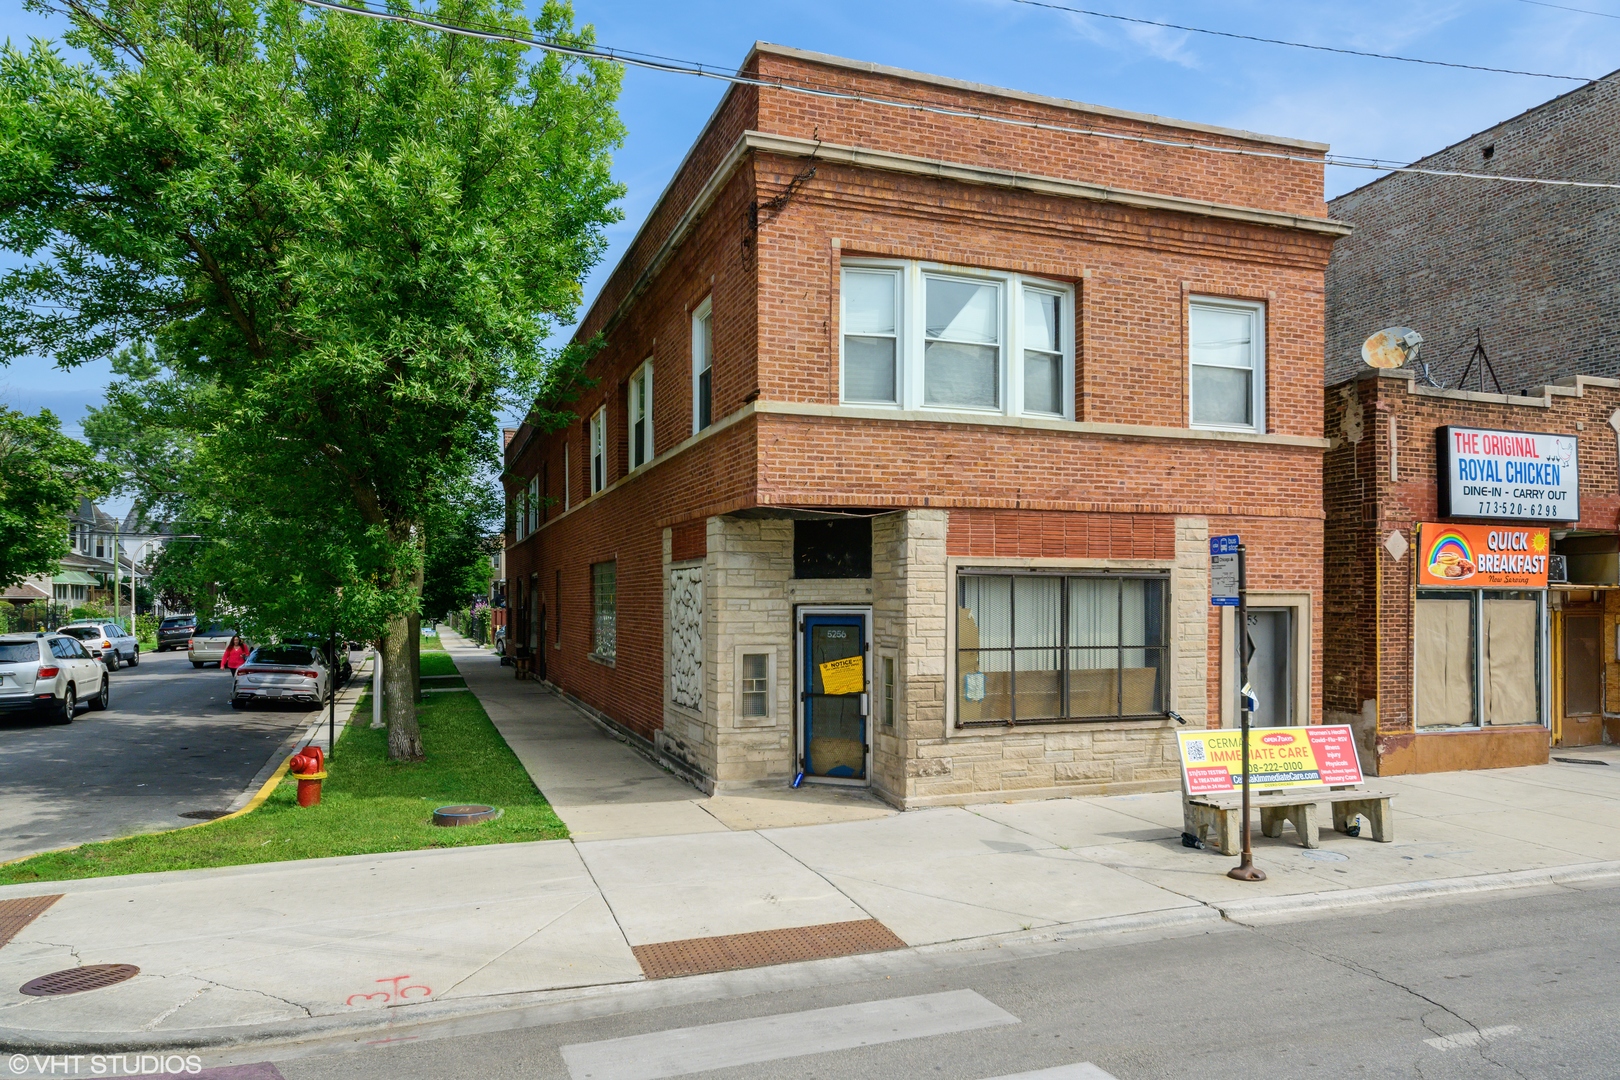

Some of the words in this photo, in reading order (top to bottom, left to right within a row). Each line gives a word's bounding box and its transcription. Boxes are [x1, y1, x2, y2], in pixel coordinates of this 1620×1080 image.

[1454, 432, 1479, 454] THE
[1482, 434, 1539, 458] ORIGINAL
[1458, 458, 1502, 483] ROYAL
[1505, 460, 1560, 486] CHICKEN
[1463, 485, 1502, 497] DINE-IN
[1513, 488, 1545, 499] CARRY
[1547, 490, 1567, 501] OUT
[1487, 531, 1529, 552] QUICK
[1477, 554, 1546, 574] BREAKFAST
[1503, 575, 1529, 584] Serving
[827, 630, 847, 638] 5256
[830, 660, 852, 668] NOTICE
[1208, 737, 1251, 748] CERMA
[1210, 748, 1275, 762] IMMEIATE
[1278, 746, 1309, 758] CARE
[1247, 761, 1303, 772] 08-222-0100
[1232, 772, 1319, 784] CeakImmediateCare.com
